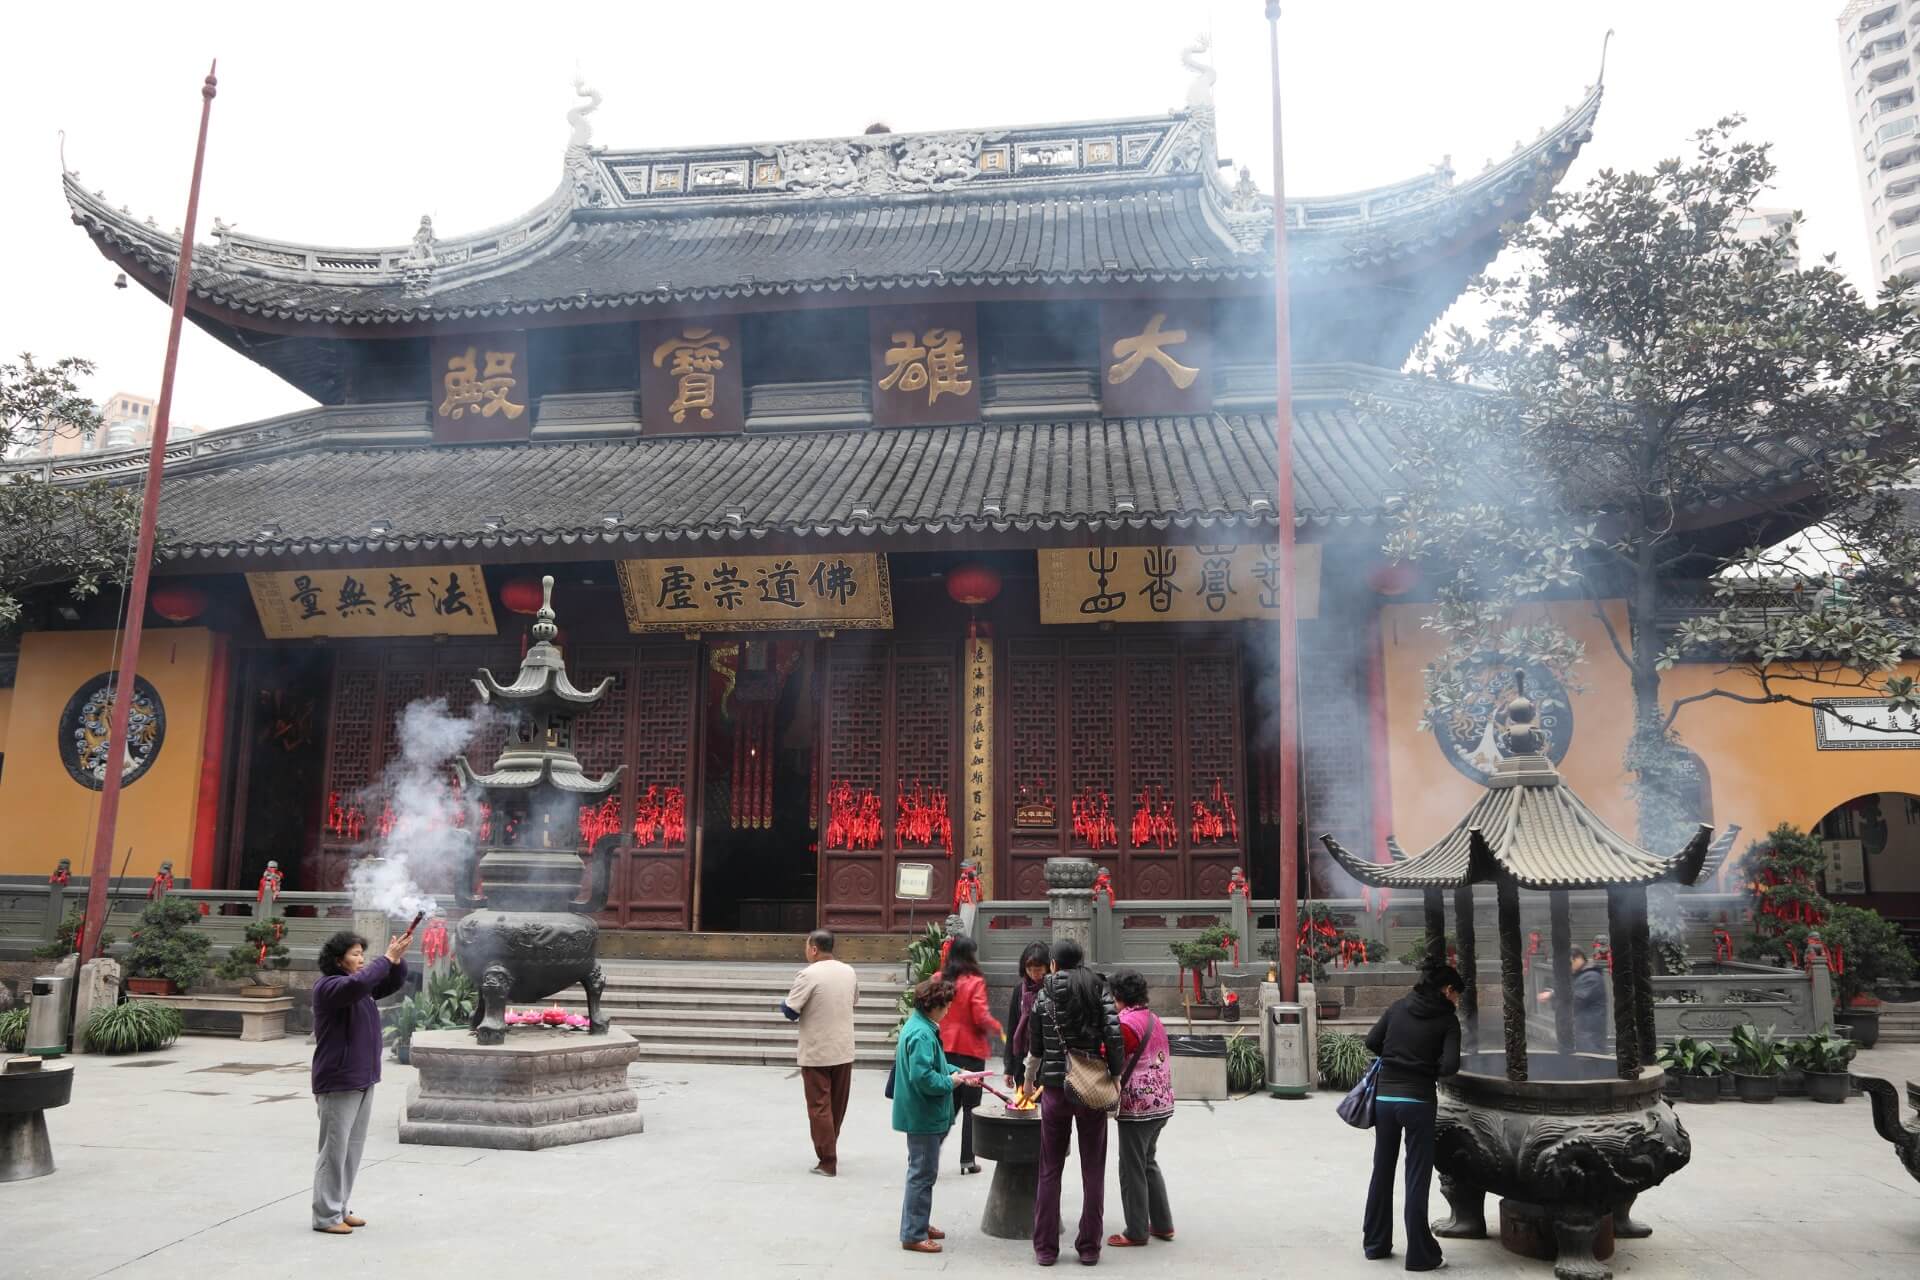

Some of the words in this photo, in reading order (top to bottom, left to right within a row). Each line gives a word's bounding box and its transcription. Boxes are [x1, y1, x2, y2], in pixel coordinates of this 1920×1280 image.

[438, 346, 525, 420] 殿
[652, 326, 731, 424] 寶
[878, 327, 973, 407] 雄
[1108, 312, 1200, 390] 大
